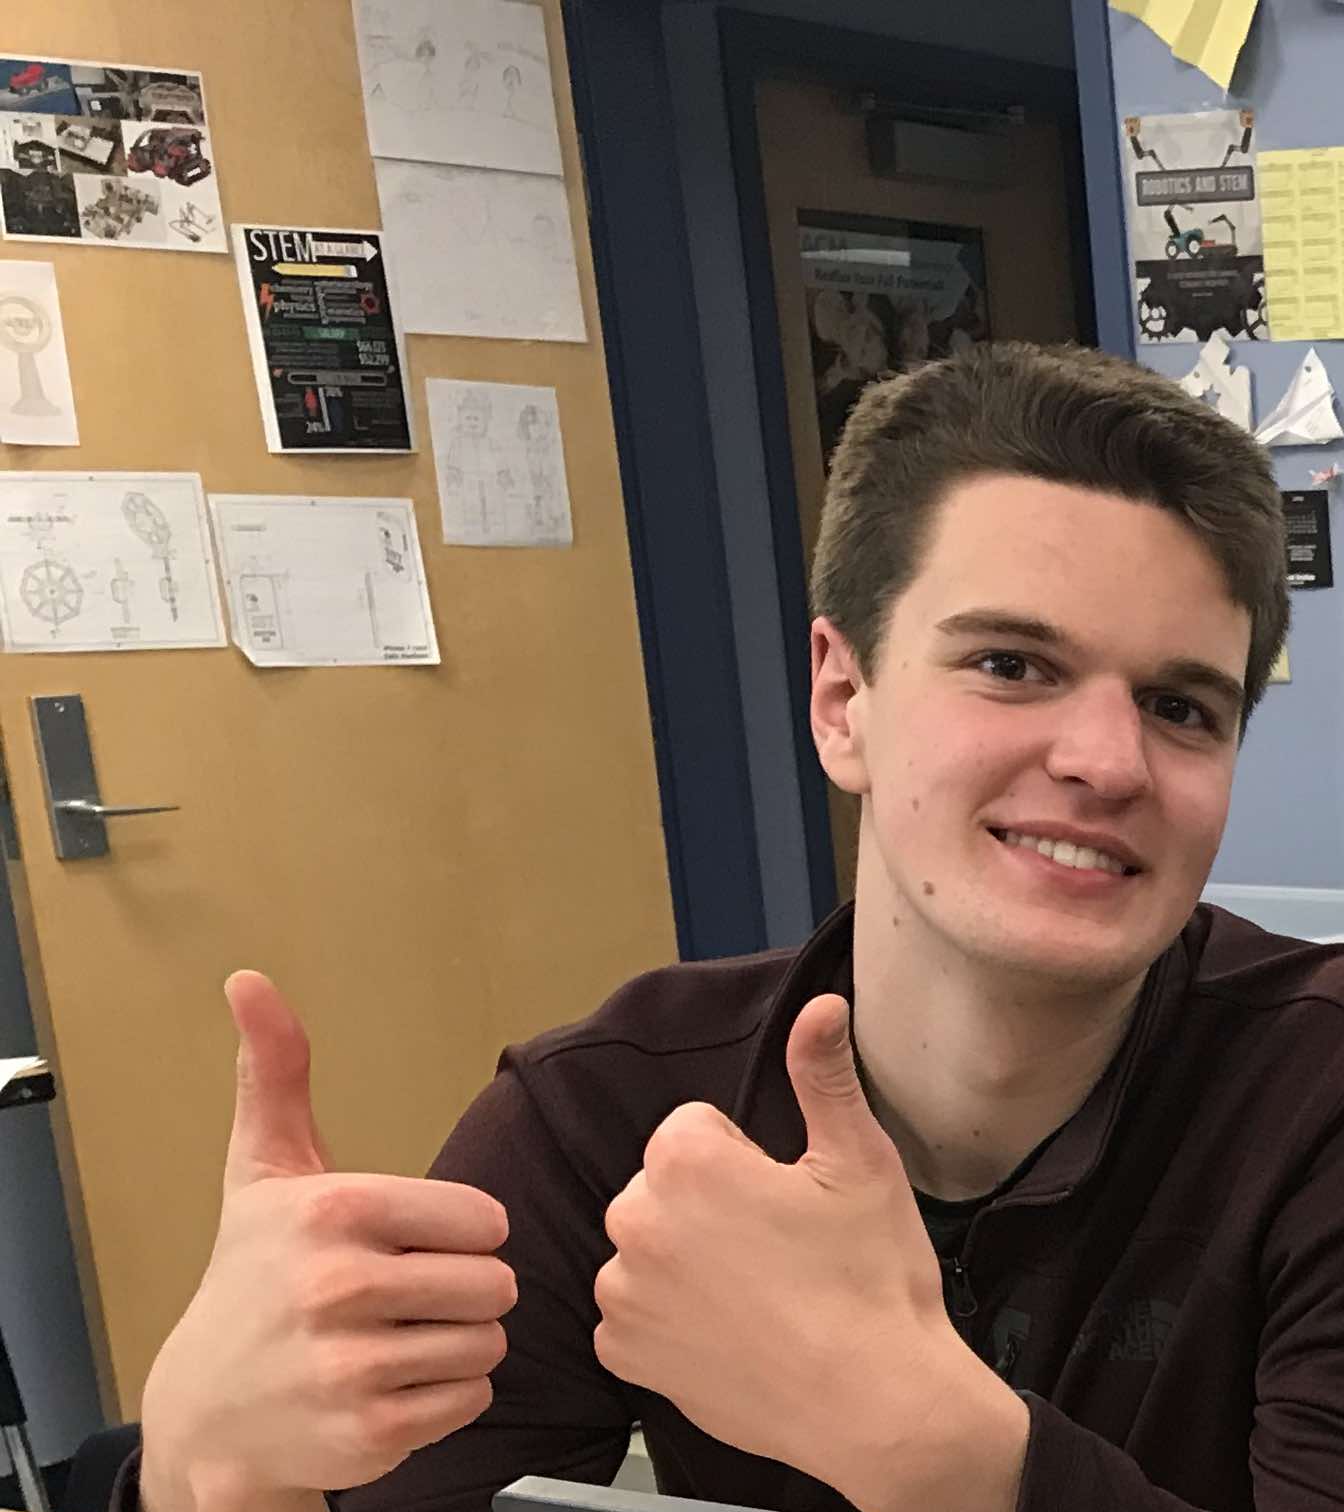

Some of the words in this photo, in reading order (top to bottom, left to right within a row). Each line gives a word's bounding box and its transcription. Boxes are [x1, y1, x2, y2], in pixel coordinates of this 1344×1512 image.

[1142, 180, 1192, 196] ROBOTICS
[1196, 178, 1217, 193] AND
[1219, 174, 1249, 192] STEM
[250, 229, 317, 263] STEM
